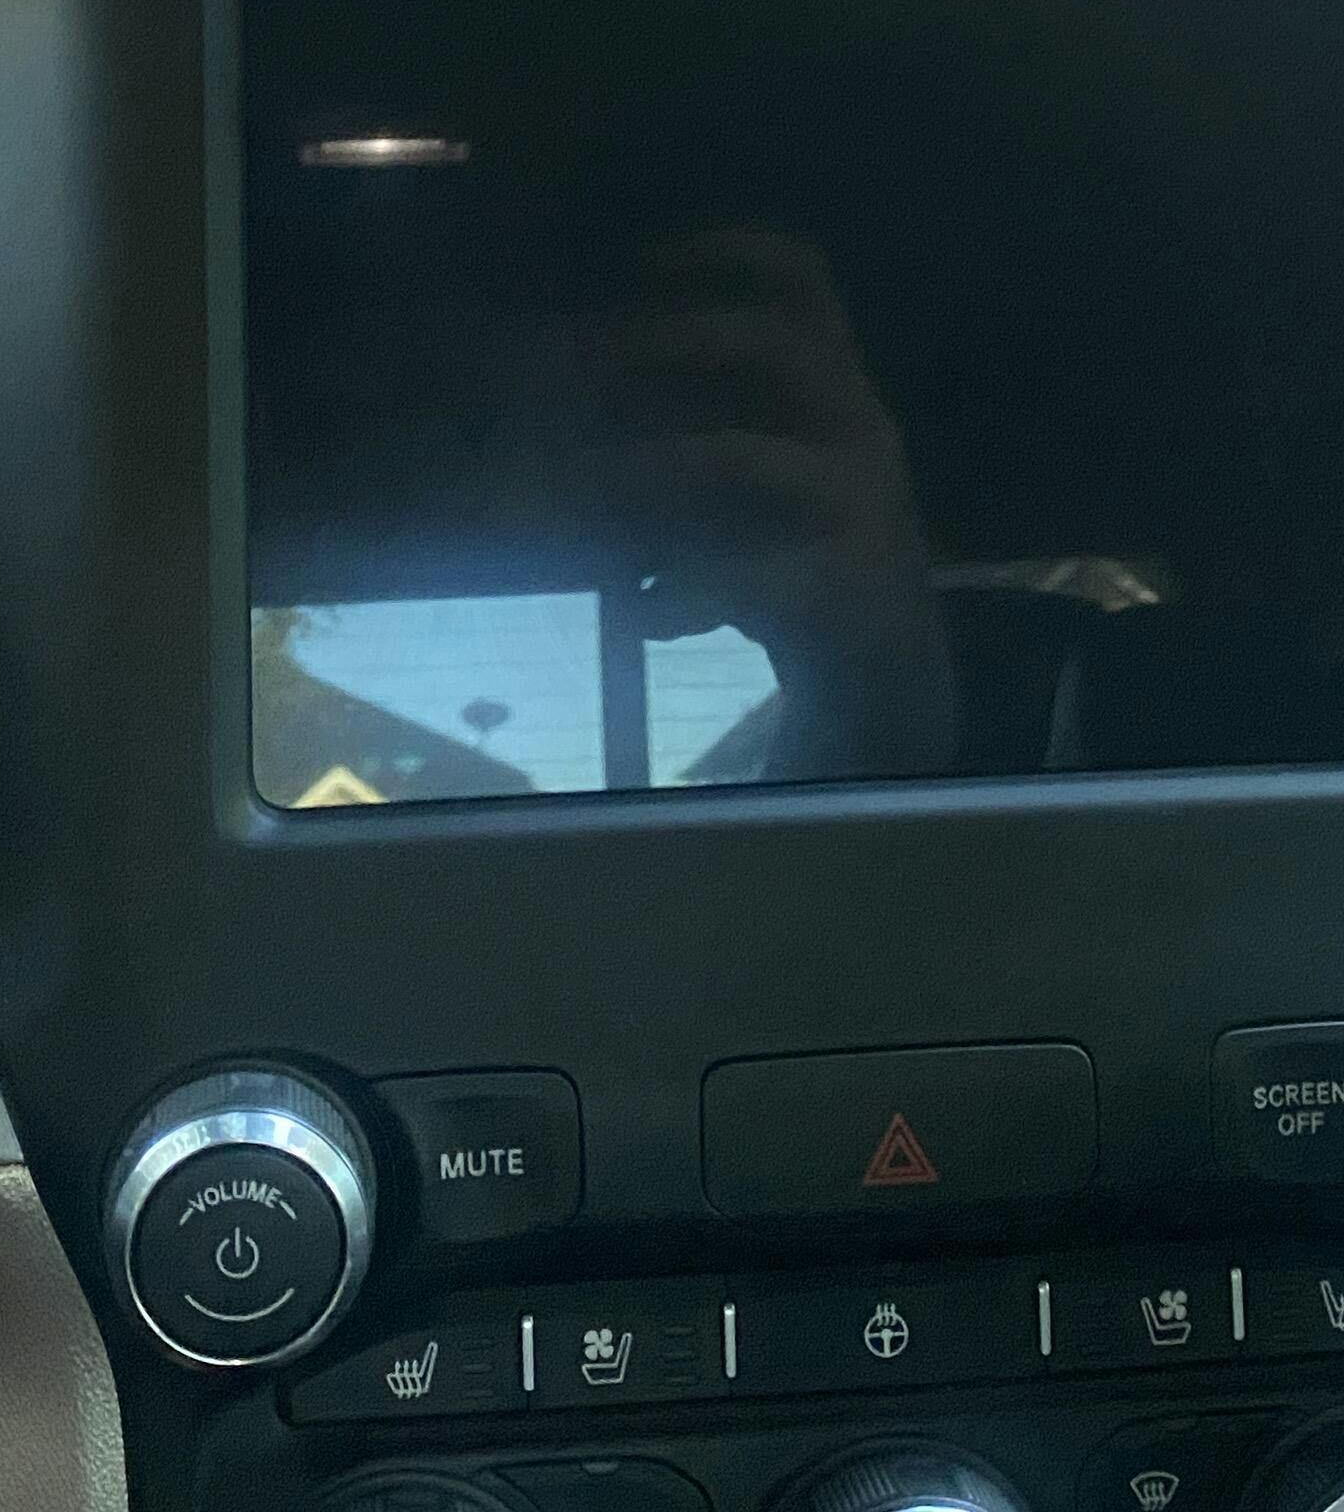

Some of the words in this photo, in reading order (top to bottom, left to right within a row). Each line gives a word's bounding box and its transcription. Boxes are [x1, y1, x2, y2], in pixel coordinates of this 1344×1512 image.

[1277, 1112, 1325, 1137] OFF
[440, 1148, 525, 1180] MUTE
[187, 1179, 283, 1214] VOLUME
